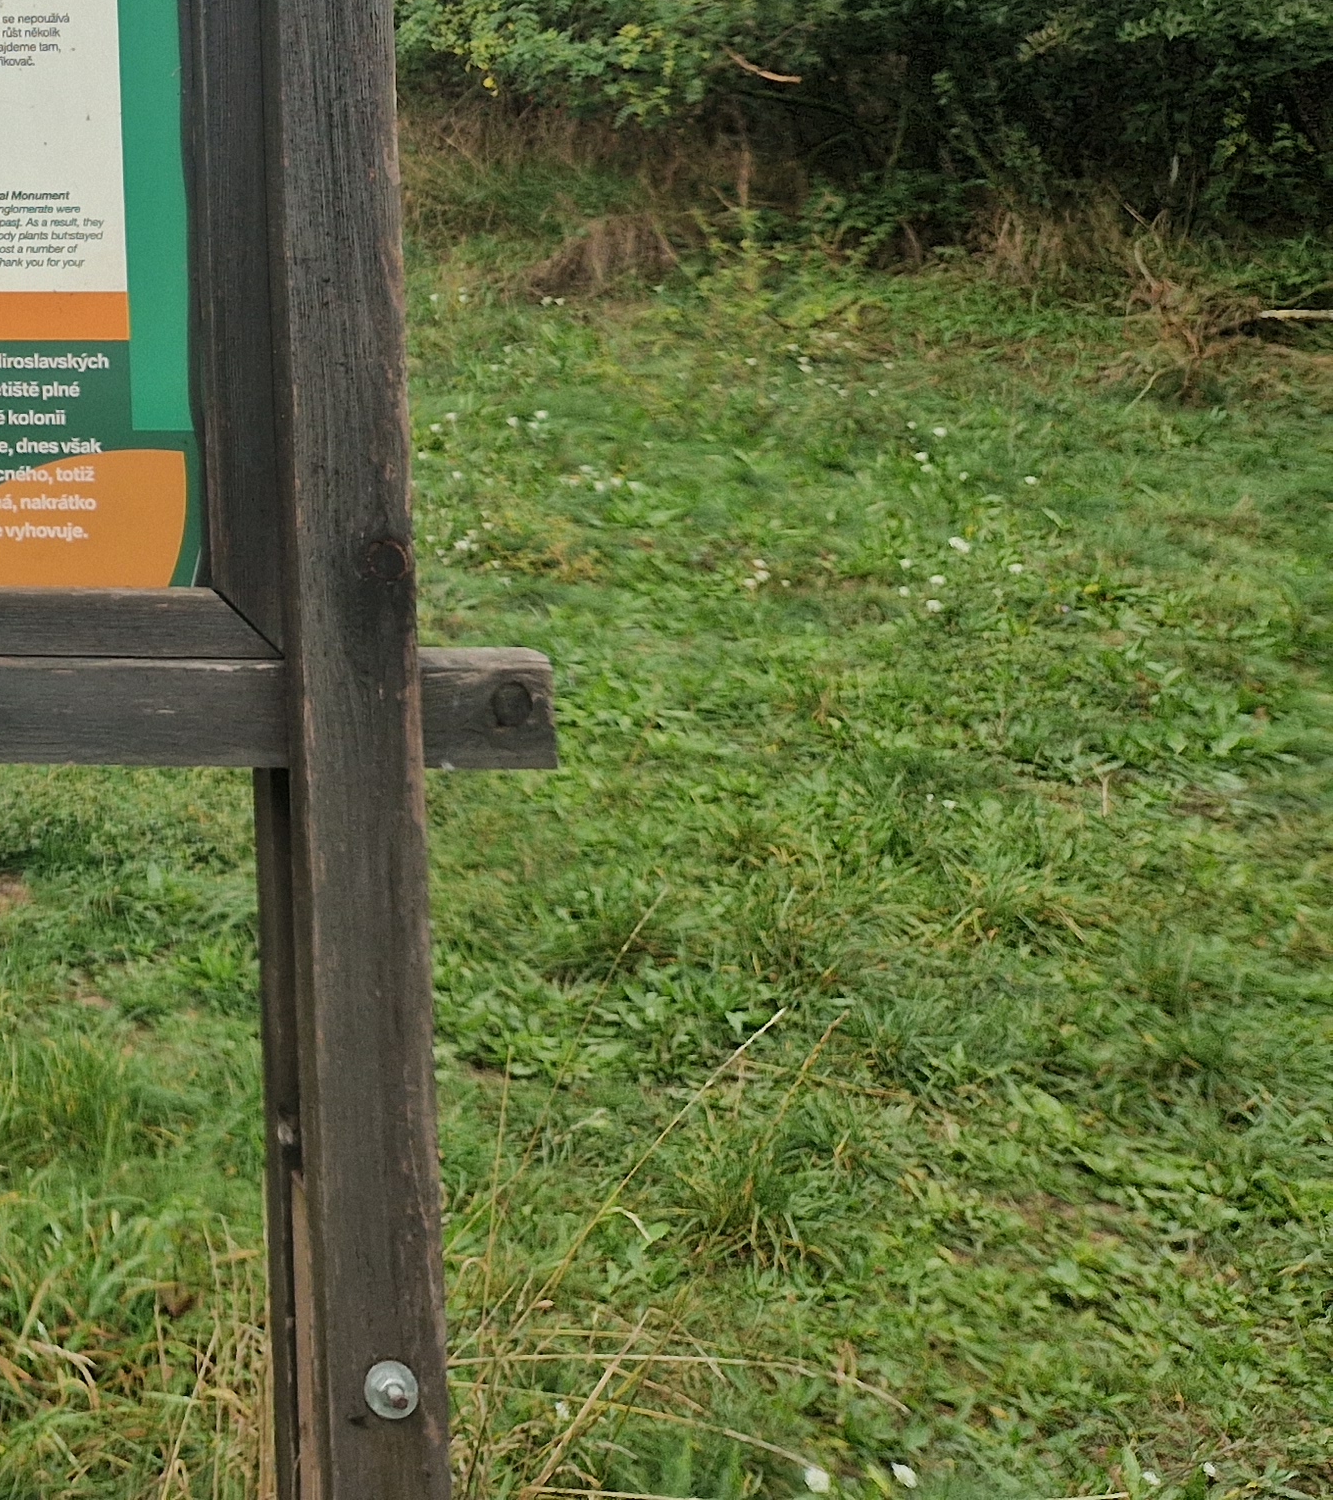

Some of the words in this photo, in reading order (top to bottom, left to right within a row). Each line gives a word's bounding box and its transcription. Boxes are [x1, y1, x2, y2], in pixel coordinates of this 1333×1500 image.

[2, 15, 15, 25] se
[17, 12, 69, 24] nepoužívá
[24, 27, 60, 37] několik
[41, 381, 80, 400] plné
[8, 409, 66, 425] kolonii
[15, 437, 59, 453] dnes
[60, 437, 102, 453] však
[55, 466, 94, 481] totiž
[20, 494, 97, 510] nakrátko
[4, 522, 88, 541] vyhovuje.
